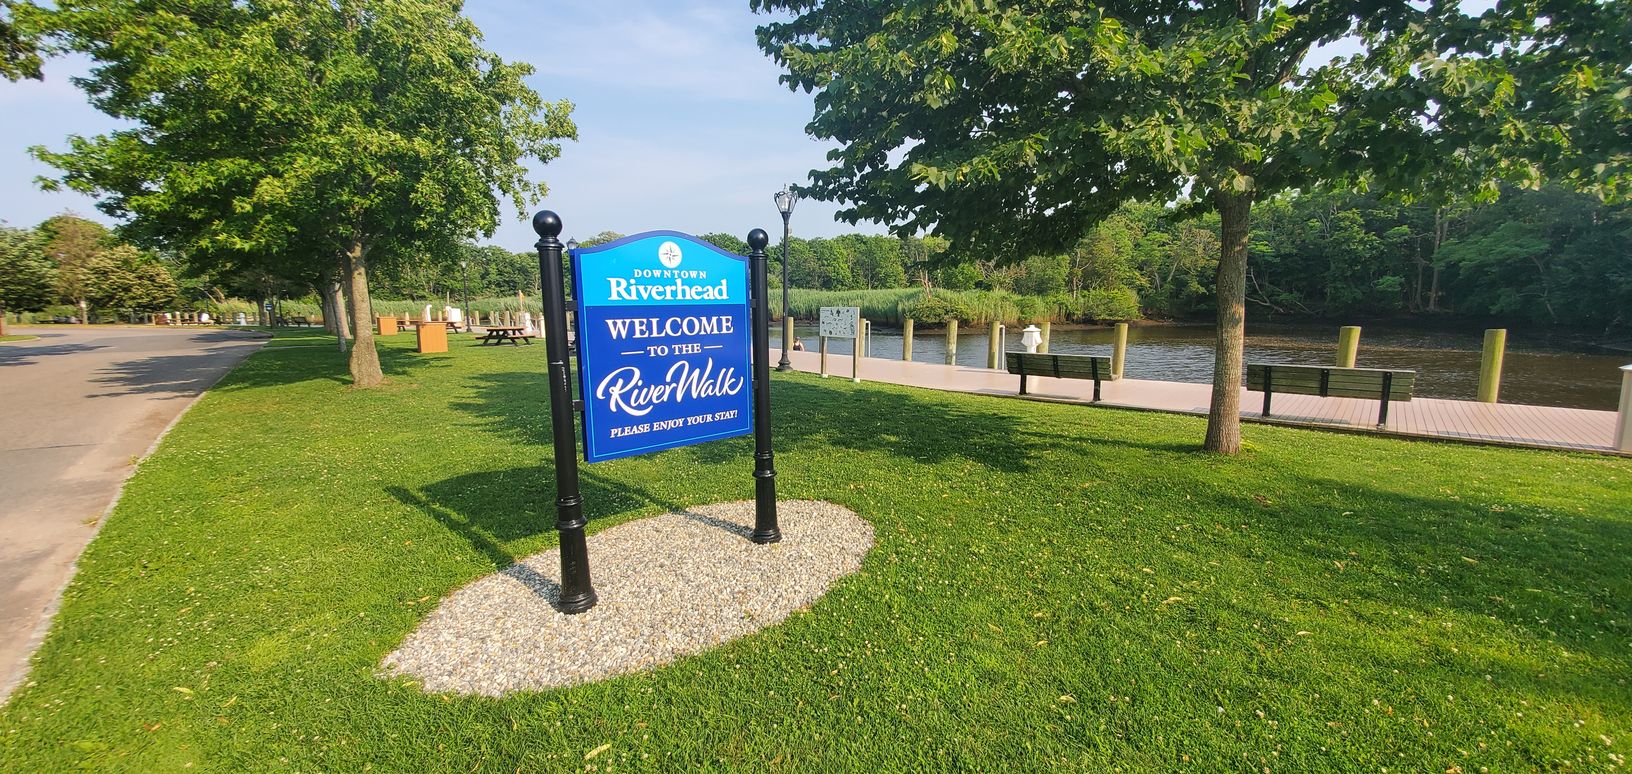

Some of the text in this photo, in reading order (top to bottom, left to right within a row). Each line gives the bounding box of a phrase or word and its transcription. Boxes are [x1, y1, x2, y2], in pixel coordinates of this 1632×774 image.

[634, 269, 707, 279] DOWNTOWN
[606, 277, 729, 301] Riverhead
[605, 315, 734, 340] WELCOME
[647, 343, 702, 357] TO THE
[596, 357, 744, 417] RiverWalk
[609, 410, 739, 439] PLEASE ENJOY YOUR STAY!
